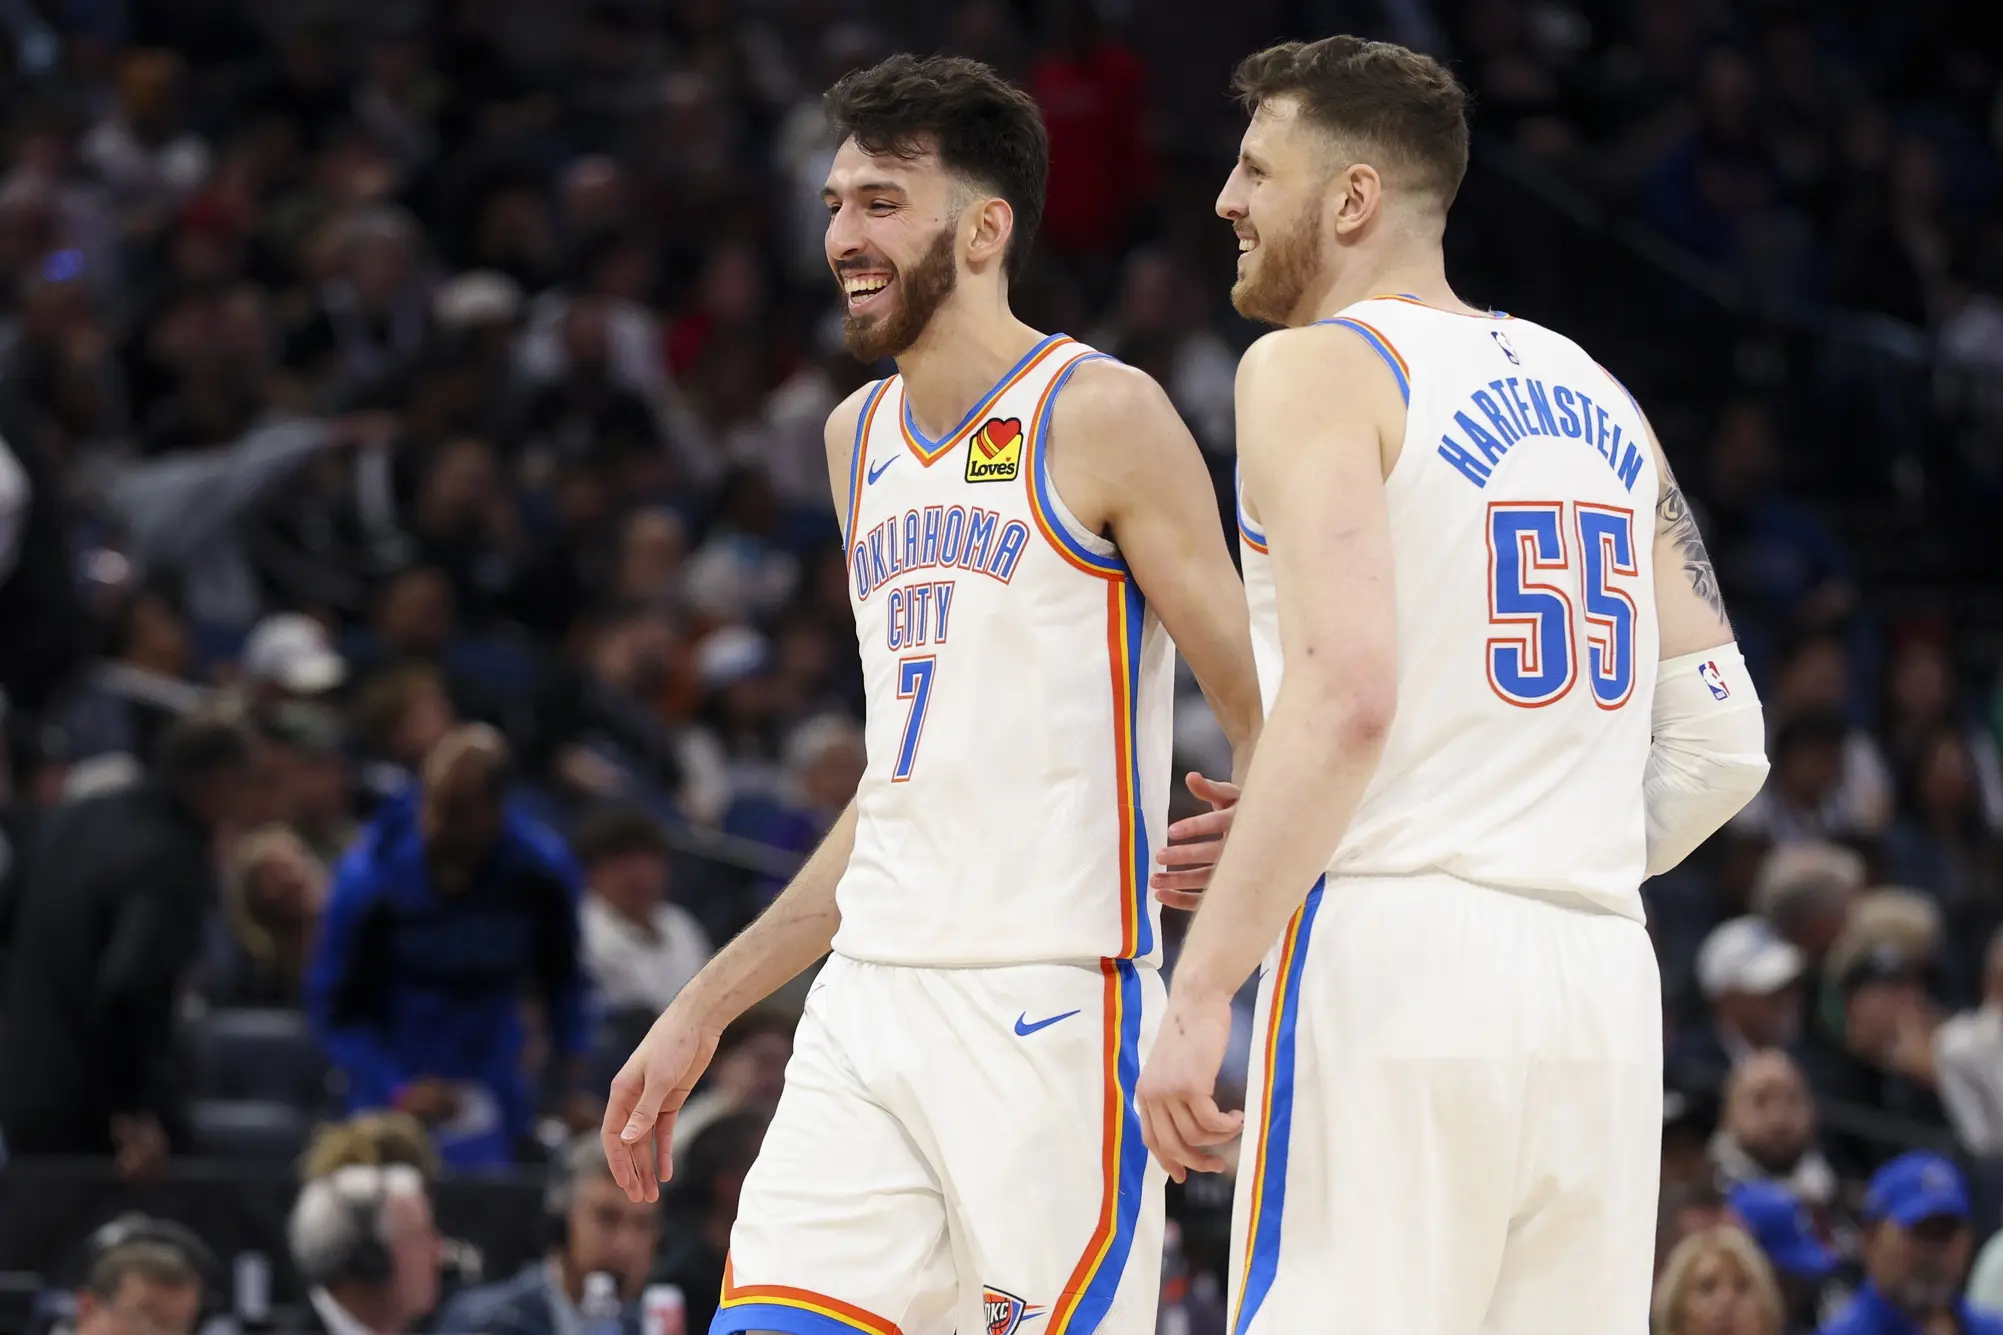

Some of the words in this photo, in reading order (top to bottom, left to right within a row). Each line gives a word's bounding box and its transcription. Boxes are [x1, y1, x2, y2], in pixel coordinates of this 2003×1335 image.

[1437, 377, 1643, 494] HARTENSTEIN
[854, 505, 1030, 601] OKLAHOMA
[1486, 500, 1638, 710] 55
[887, 580, 955, 651] CITY
[891, 654, 936, 783] 7
